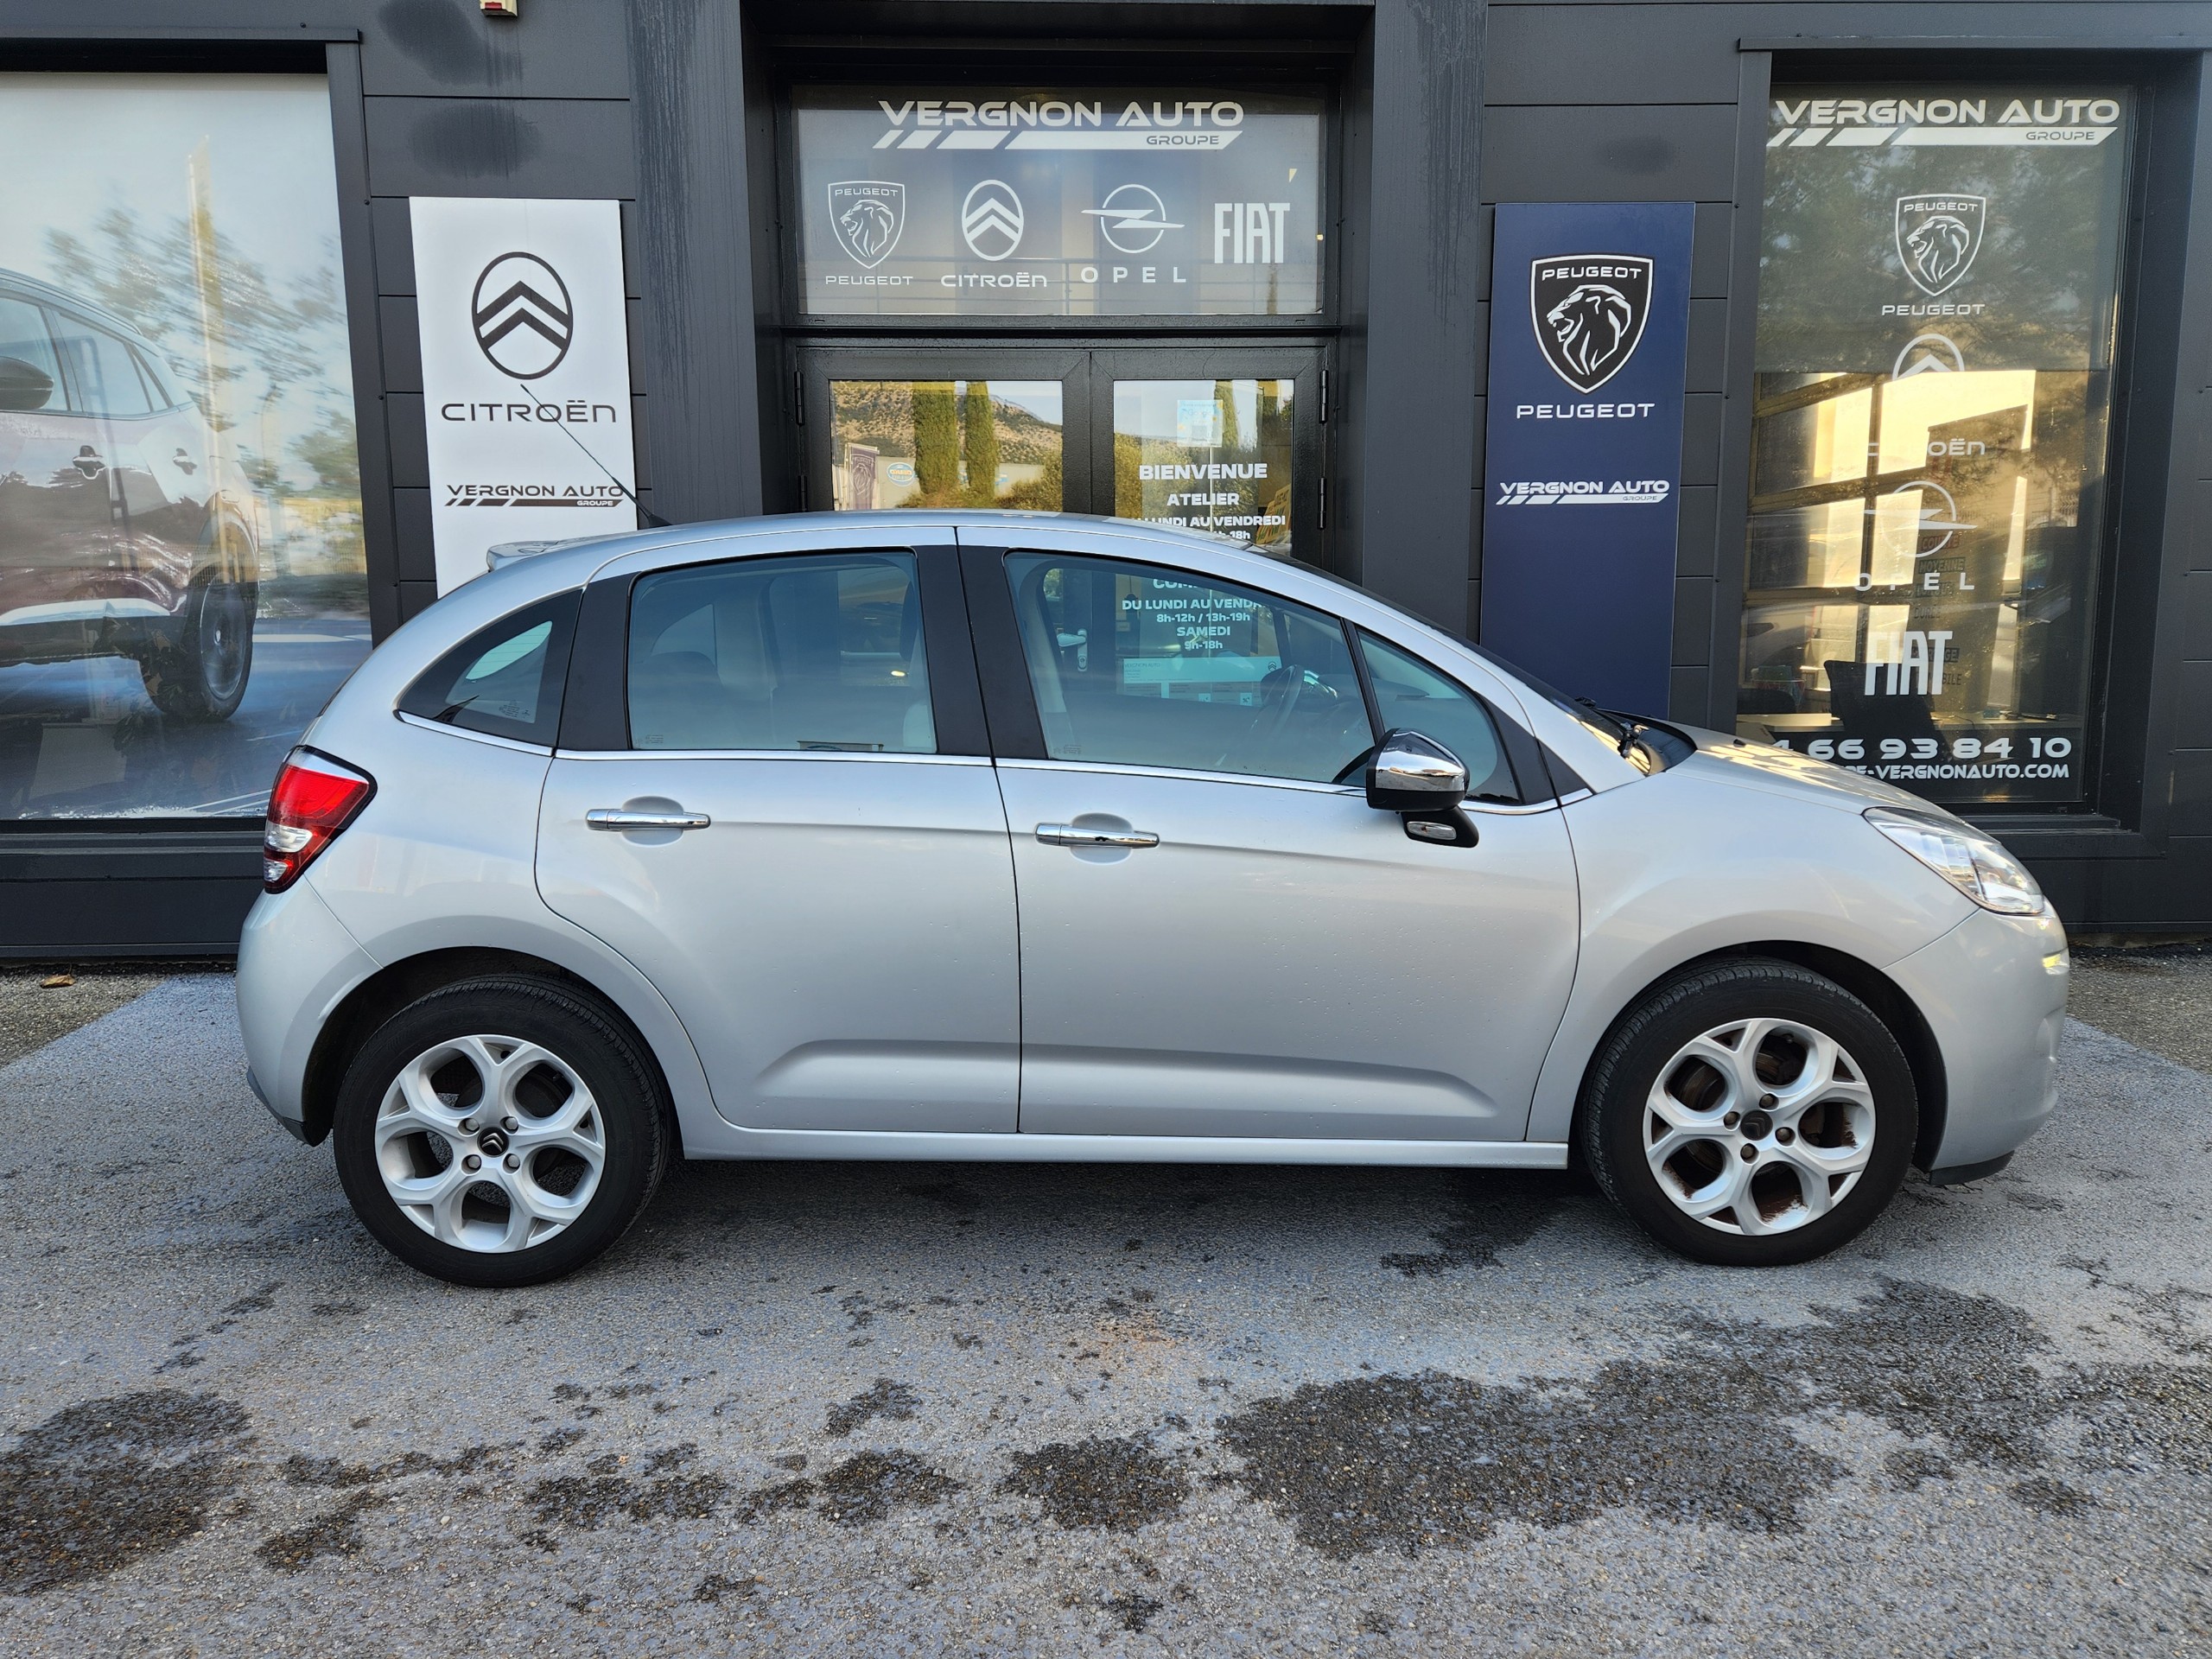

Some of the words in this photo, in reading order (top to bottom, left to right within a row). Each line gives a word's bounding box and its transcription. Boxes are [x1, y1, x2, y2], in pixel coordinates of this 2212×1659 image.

[878, 100, 1102, 127] VERGNON
[1116, 100, 1244, 127] AUTO
[1775, 99, 1986, 124] VERGNON
[1998, 99, 2120, 124] AUTO
[1146, 135, 1220, 146] GROUPE
[2025, 131, 2095, 141] GROUPE
[834, 188, 899, 198] PEUGEOT
[1904, 201, 1978, 213] PEUGEOT
[1214, 202, 1291, 264] FIAT
[1080, 266, 1187, 284] OPEL
[1541, 265, 1643, 281] PEUGEOT
[824, 276, 913, 287] PEUGEOT
[1881, 303, 1986, 316] PEUGEOT
[1516, 402, 1656, 420] PEUGEOT
[1139, 462, 1268, 481] BIENVENUE
[446, 484, 556, 498] VERGNON
[562, 484, 625, 498] AUTO
[1499, 480, 1604, 495] VERGNON
[1607, 480, 1670, 494] AUTO
[1166, 492, 1240, 506] ATELIER
[1190, 517, 1210, 527] AU
[1212, 515, 1286, 527] VENDREDI
[1122, 600, 1142, 610] DU
[1145, 599, 1187, 610] LUNDI
[1190, 599, 1211, 609] AU
[1156, 613, 1196, 623] 8h-12h
[1205, 613, 1250, 622] 13h-19h
[1176, 626, 1231, 637] SAMEDI
[1184, 640, 1224, 651] 9h-18h
[1865, 630, 1954, 696] FIAT
[1808, 738, 1866, 760] 66
[1879, 738, 1939, 760] 93
[1952, 737, 2014, 760] 84
[2029, 737, 2072, 759] 10
